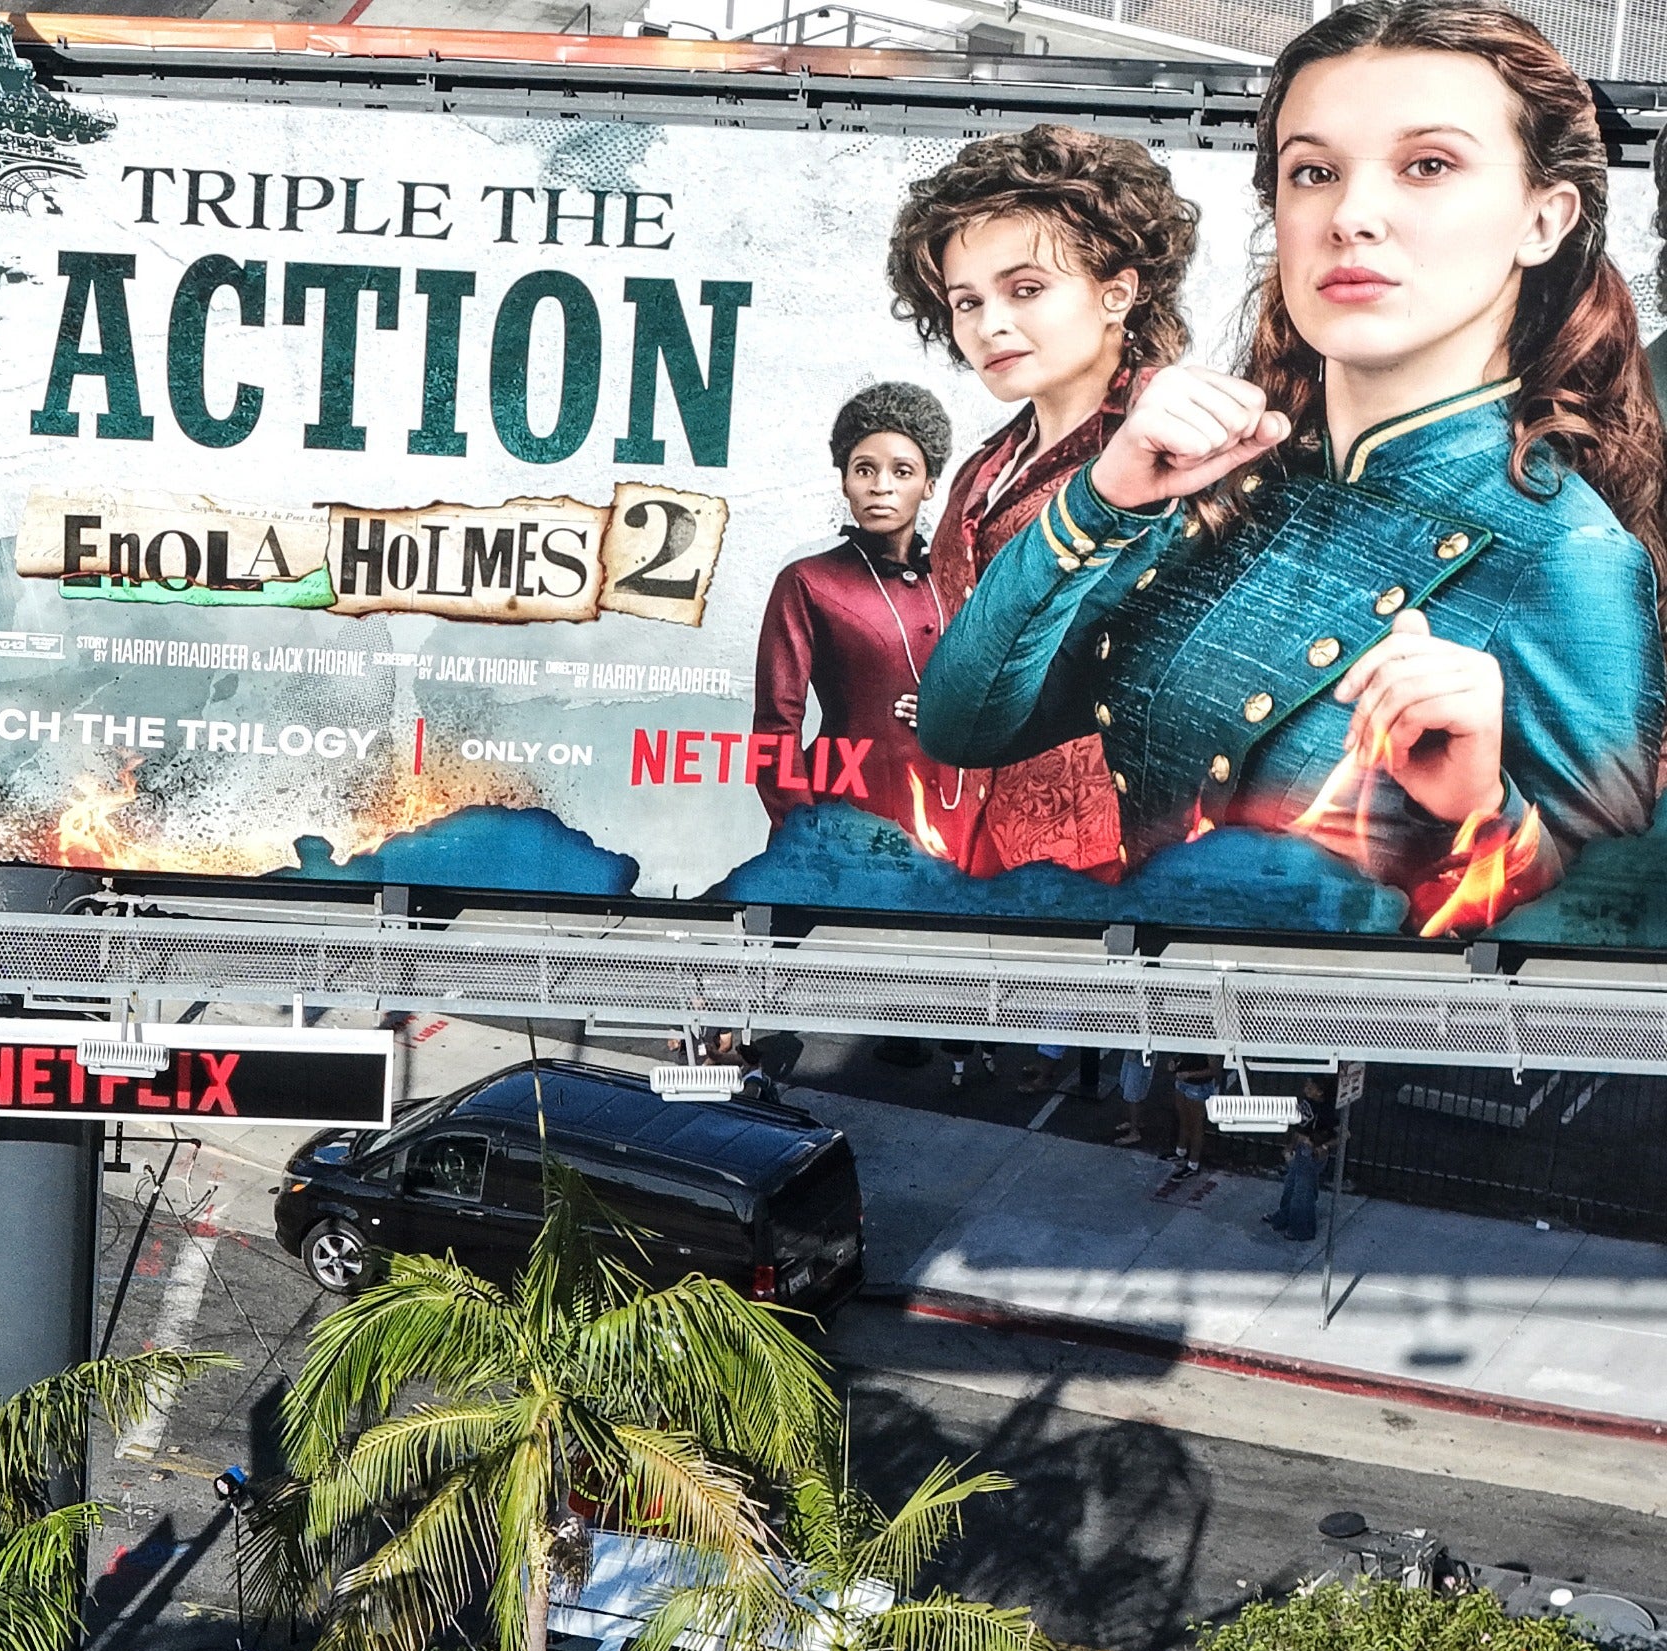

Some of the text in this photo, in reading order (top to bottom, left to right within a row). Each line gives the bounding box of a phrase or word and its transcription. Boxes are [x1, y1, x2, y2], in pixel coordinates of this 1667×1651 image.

[122, 165, 676, 250] TRIPLE THE
[30, 250, 753, 468] ACTION
[613, 499, 702, 600] 2
[76, 635, 109, 650] STORY
[93, 649, 108, 663] BY
[111, 637, 165, 666] HARRY
[167, 640, 248, 670] BRADBEER
[252, 654, 262, 671] &
[264, 646, 304, 674] JACK
[306, 648, 366, 677] THORNE
[372, 651, 434, 668] SCREENPLAY
[418, 667, 433, 680] BY
[436, 656, 476, 683] JACK
[478, 657, 539, 686] THORNE
[545, 660, 590, 676] DIRECTED
[573, 675, 589, 688] BY
[592, 663, 646, 691] HARRY
[648, 665, 731, 695] BRADBEER
[73, 712, 166, 749] THE
[177, 719, 380, 760] TRILOGY
[461, 738, 543, 764] ONLY
[548, 741, 593, 767] ON
[631, 727, 875, 799] NETFLIX
